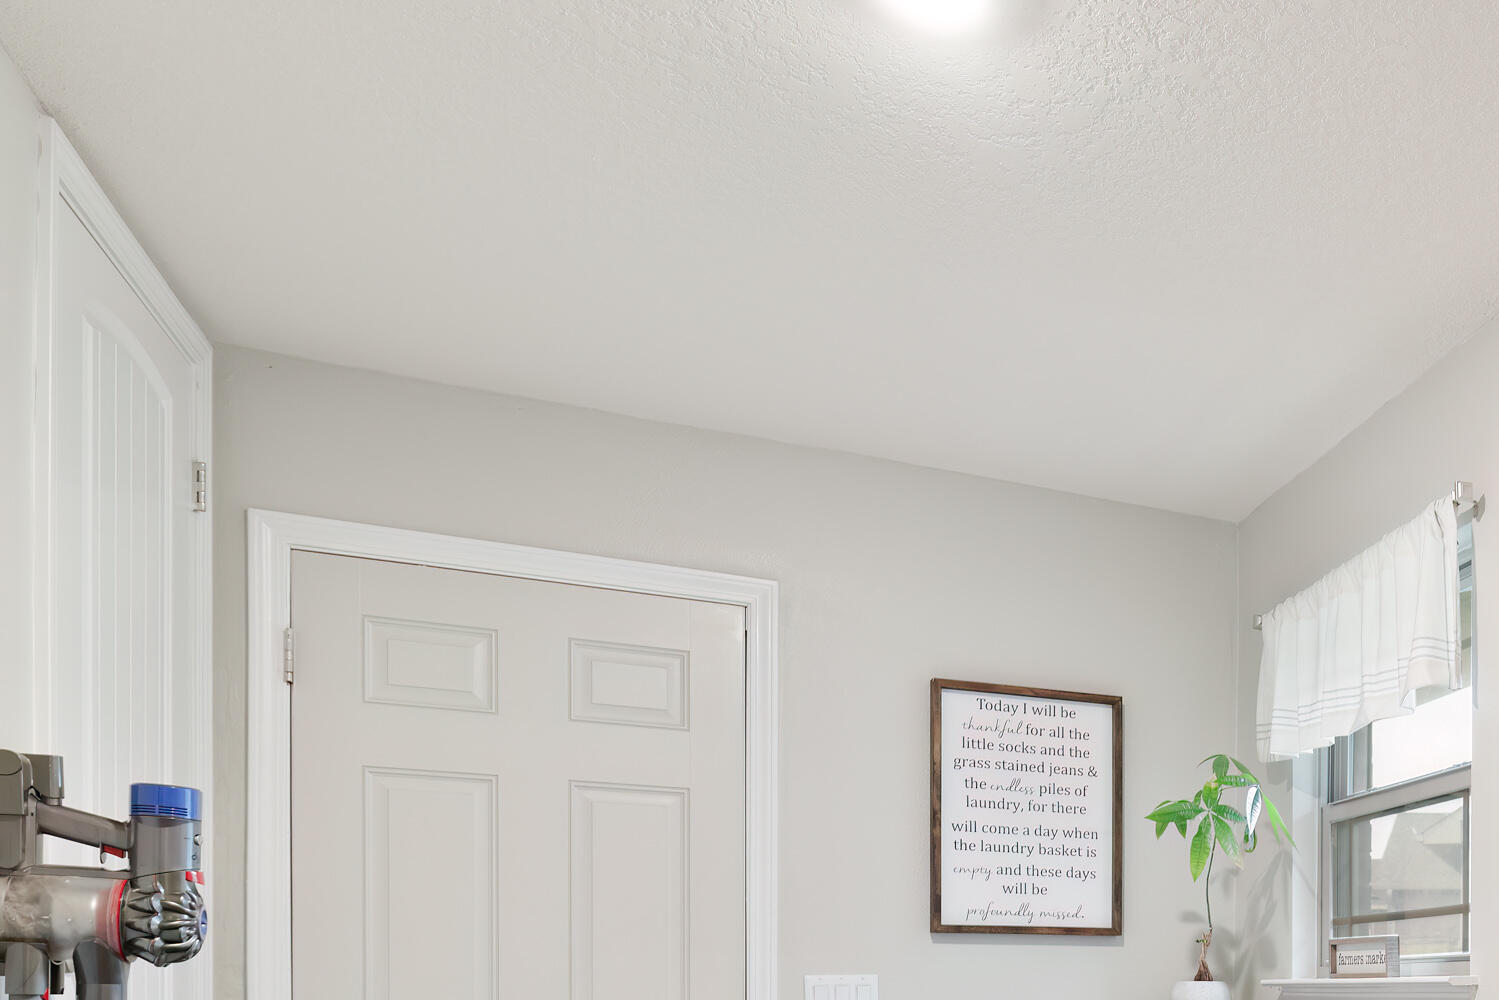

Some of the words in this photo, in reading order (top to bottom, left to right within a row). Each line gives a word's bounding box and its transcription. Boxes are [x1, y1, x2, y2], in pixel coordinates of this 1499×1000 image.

[976, 696, 1020, 716] Today
[1024, 703, 1027, 714] I
[1032, 705, 1056, 717] will
[1061, 706, 1076, 719] be
[962, 716, 1023, 738] thankful
[1026, 723, 1045, 736] for
[1049, 726, 1064, 738] all
[1069, 728, 1089, 740] the
[963, 736, 994, 750] little
[999, 741, 1036, 754] socks
[1040, 745, 1064, 756] and
[1070, 746, 1090, 758] the
[954, 758, 990, 770] grass
[995, 760, 1044, 773] stained
[1049, 763, 1083, 776] jeans
[1088, 766, 1098, 777] &
[965, 777, 986, 789] the
[990, 778, 1034, 795] endless
[1040, 784, 1071, 797] piles
[1075, 785, 1088, 797] of
[967, 795, 1023, 814] laundry,
[1029, 800, 1047, 812] for
[1052, 801, 1086, 815] there
[952, 820, 976, 832] will
[982, 825, 1018, 835] come
[1023, 827, 1029, 835] a
[1035, 825, 1058, 840] day
[1063, 827, 1098, 840] when
[954, 839, 976, 851] the
[981, 840, 1034, 857] laundry
[1039, 844, 1082, 856] basket
[1087, 846, 1096, 857] is
[953, 866, 991, 881] empty
[997, 864, 1021, 875] and
[1027, 865, 1061, 877] these
[1066, 867, 1096, 881] days
[1003, 882, 1026, 894] will
[1032, 883, 1047, 895] be
[965, 902, 1034, 924] profoundly
[1040, 906, 1084, 919] missed.
[1338, 953, 1364, 966] farmers
[1365, 951, 1386, 965] mark
